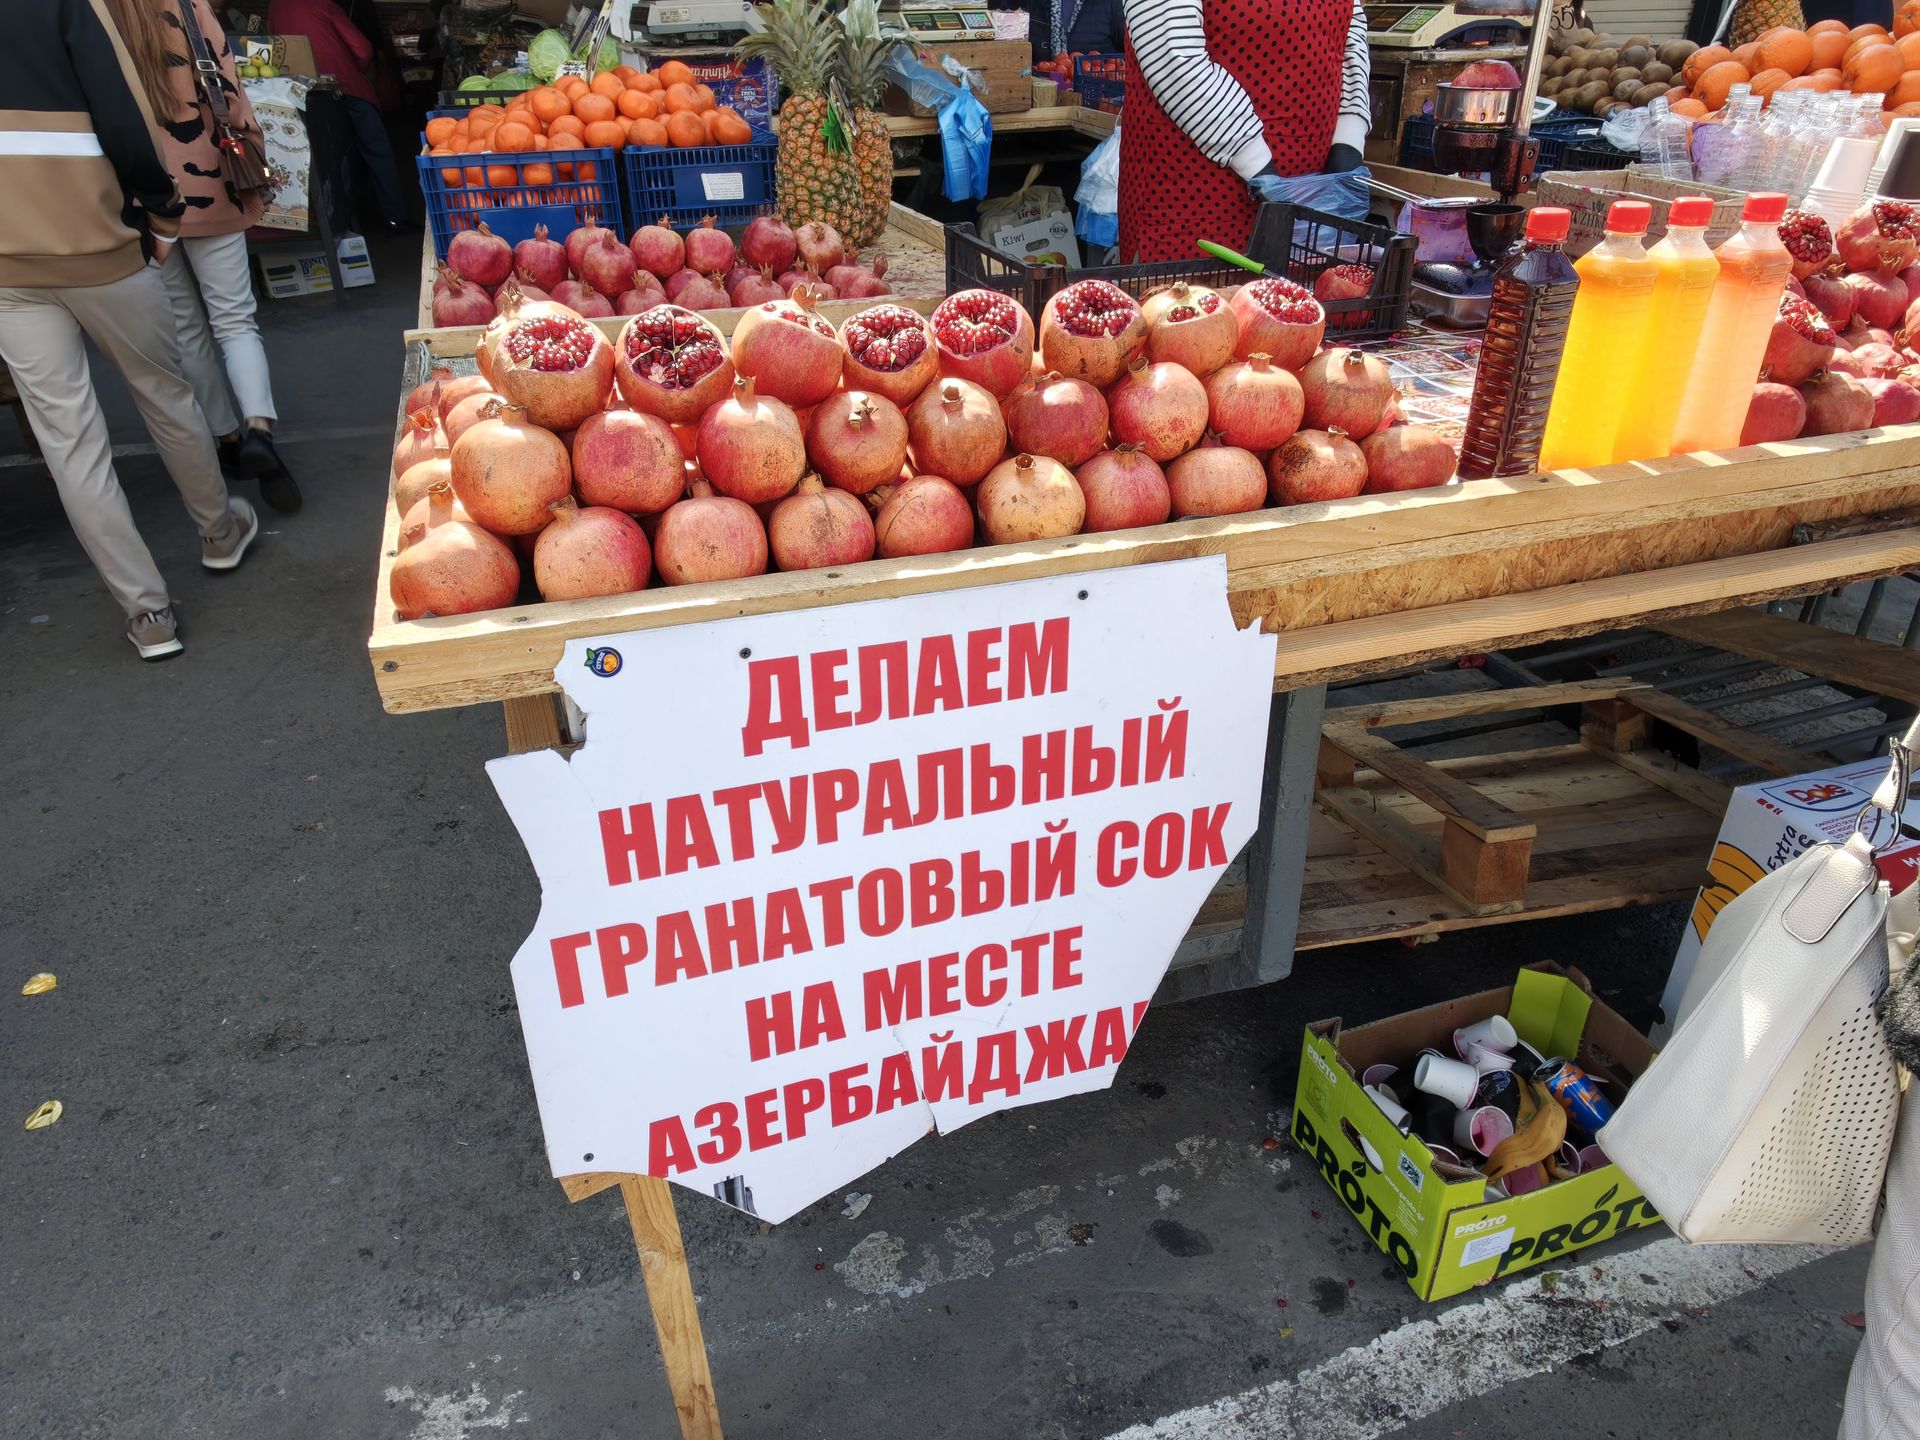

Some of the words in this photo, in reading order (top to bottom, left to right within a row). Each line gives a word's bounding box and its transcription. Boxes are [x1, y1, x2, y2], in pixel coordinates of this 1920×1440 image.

[743, 618, 1069, 755] ДЕЛАЕМ
[600, 697, 1188, 885] НАТУРАЛЬНЫЙ
[1767, 825, 1798, 870] Extra
[1786, 784, 1846, 803] Dole
[552, 819, 1076, 1007] ГРАНАТОВЫЙ
[1098, 803, 1230, 887] СОК
[747, 982, 845, 1060] НА
[864, 927, 1082, 1030] МЕСТЕ
[649, 1001, 1147, 1179] АЗЕРБАЙДЖА
